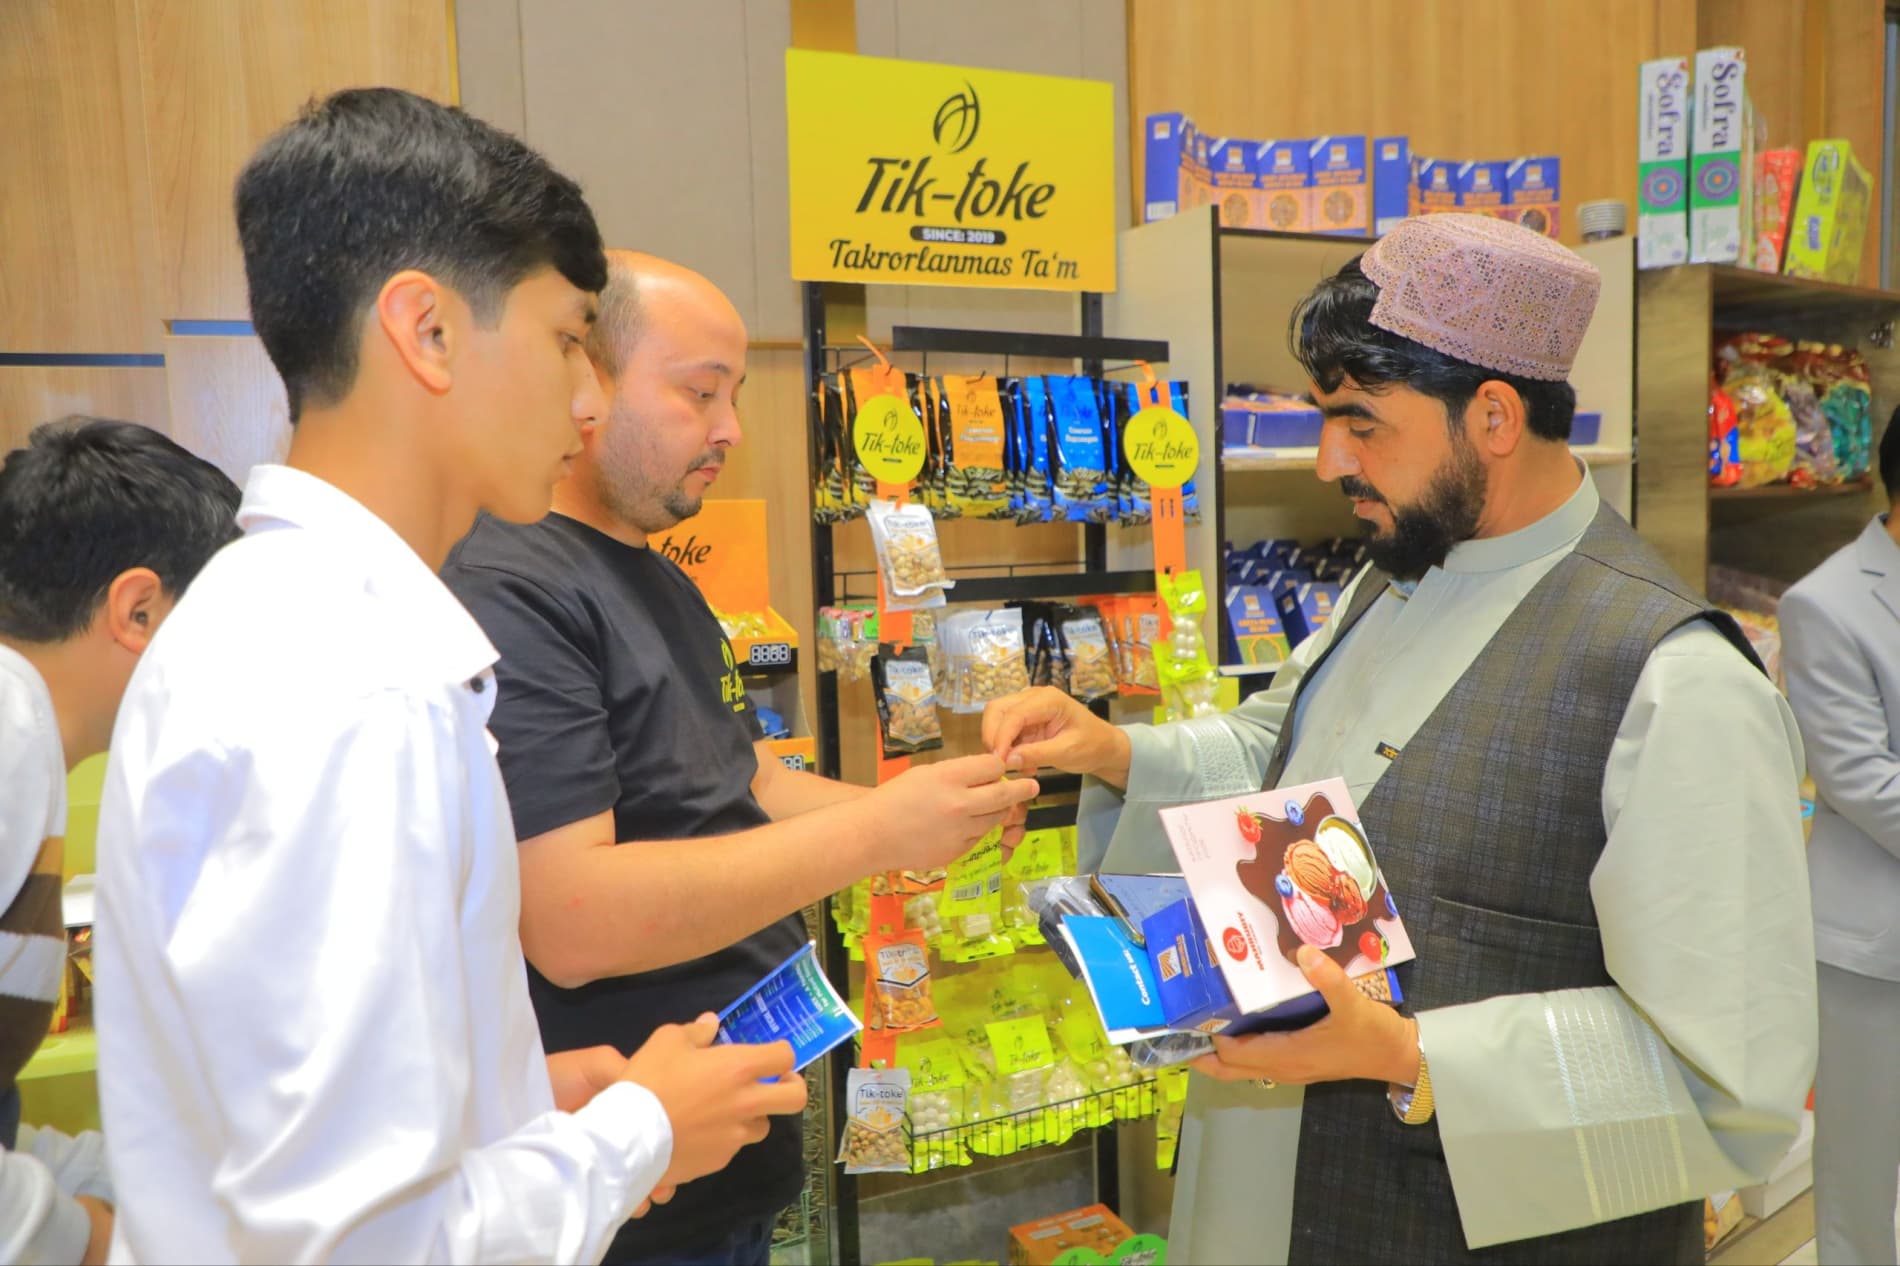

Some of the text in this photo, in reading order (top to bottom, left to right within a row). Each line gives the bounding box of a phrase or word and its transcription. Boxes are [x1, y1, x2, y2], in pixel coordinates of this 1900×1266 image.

[1711, 61, 1740, 149] Sofra
[855, 155, 1057, 224] Tik-toke
[921, 227, 996, 245] SINCE: 2019
[828, 238, 1013, 277] Takrorlanmas
[861, 431, 921, 456] Tik-toke
[1134, 440, 1194, 462] Tik-toke
[1130, 964, 1150, 1005] Contact
[860, 1088, 903, 1098] Tik-toke
